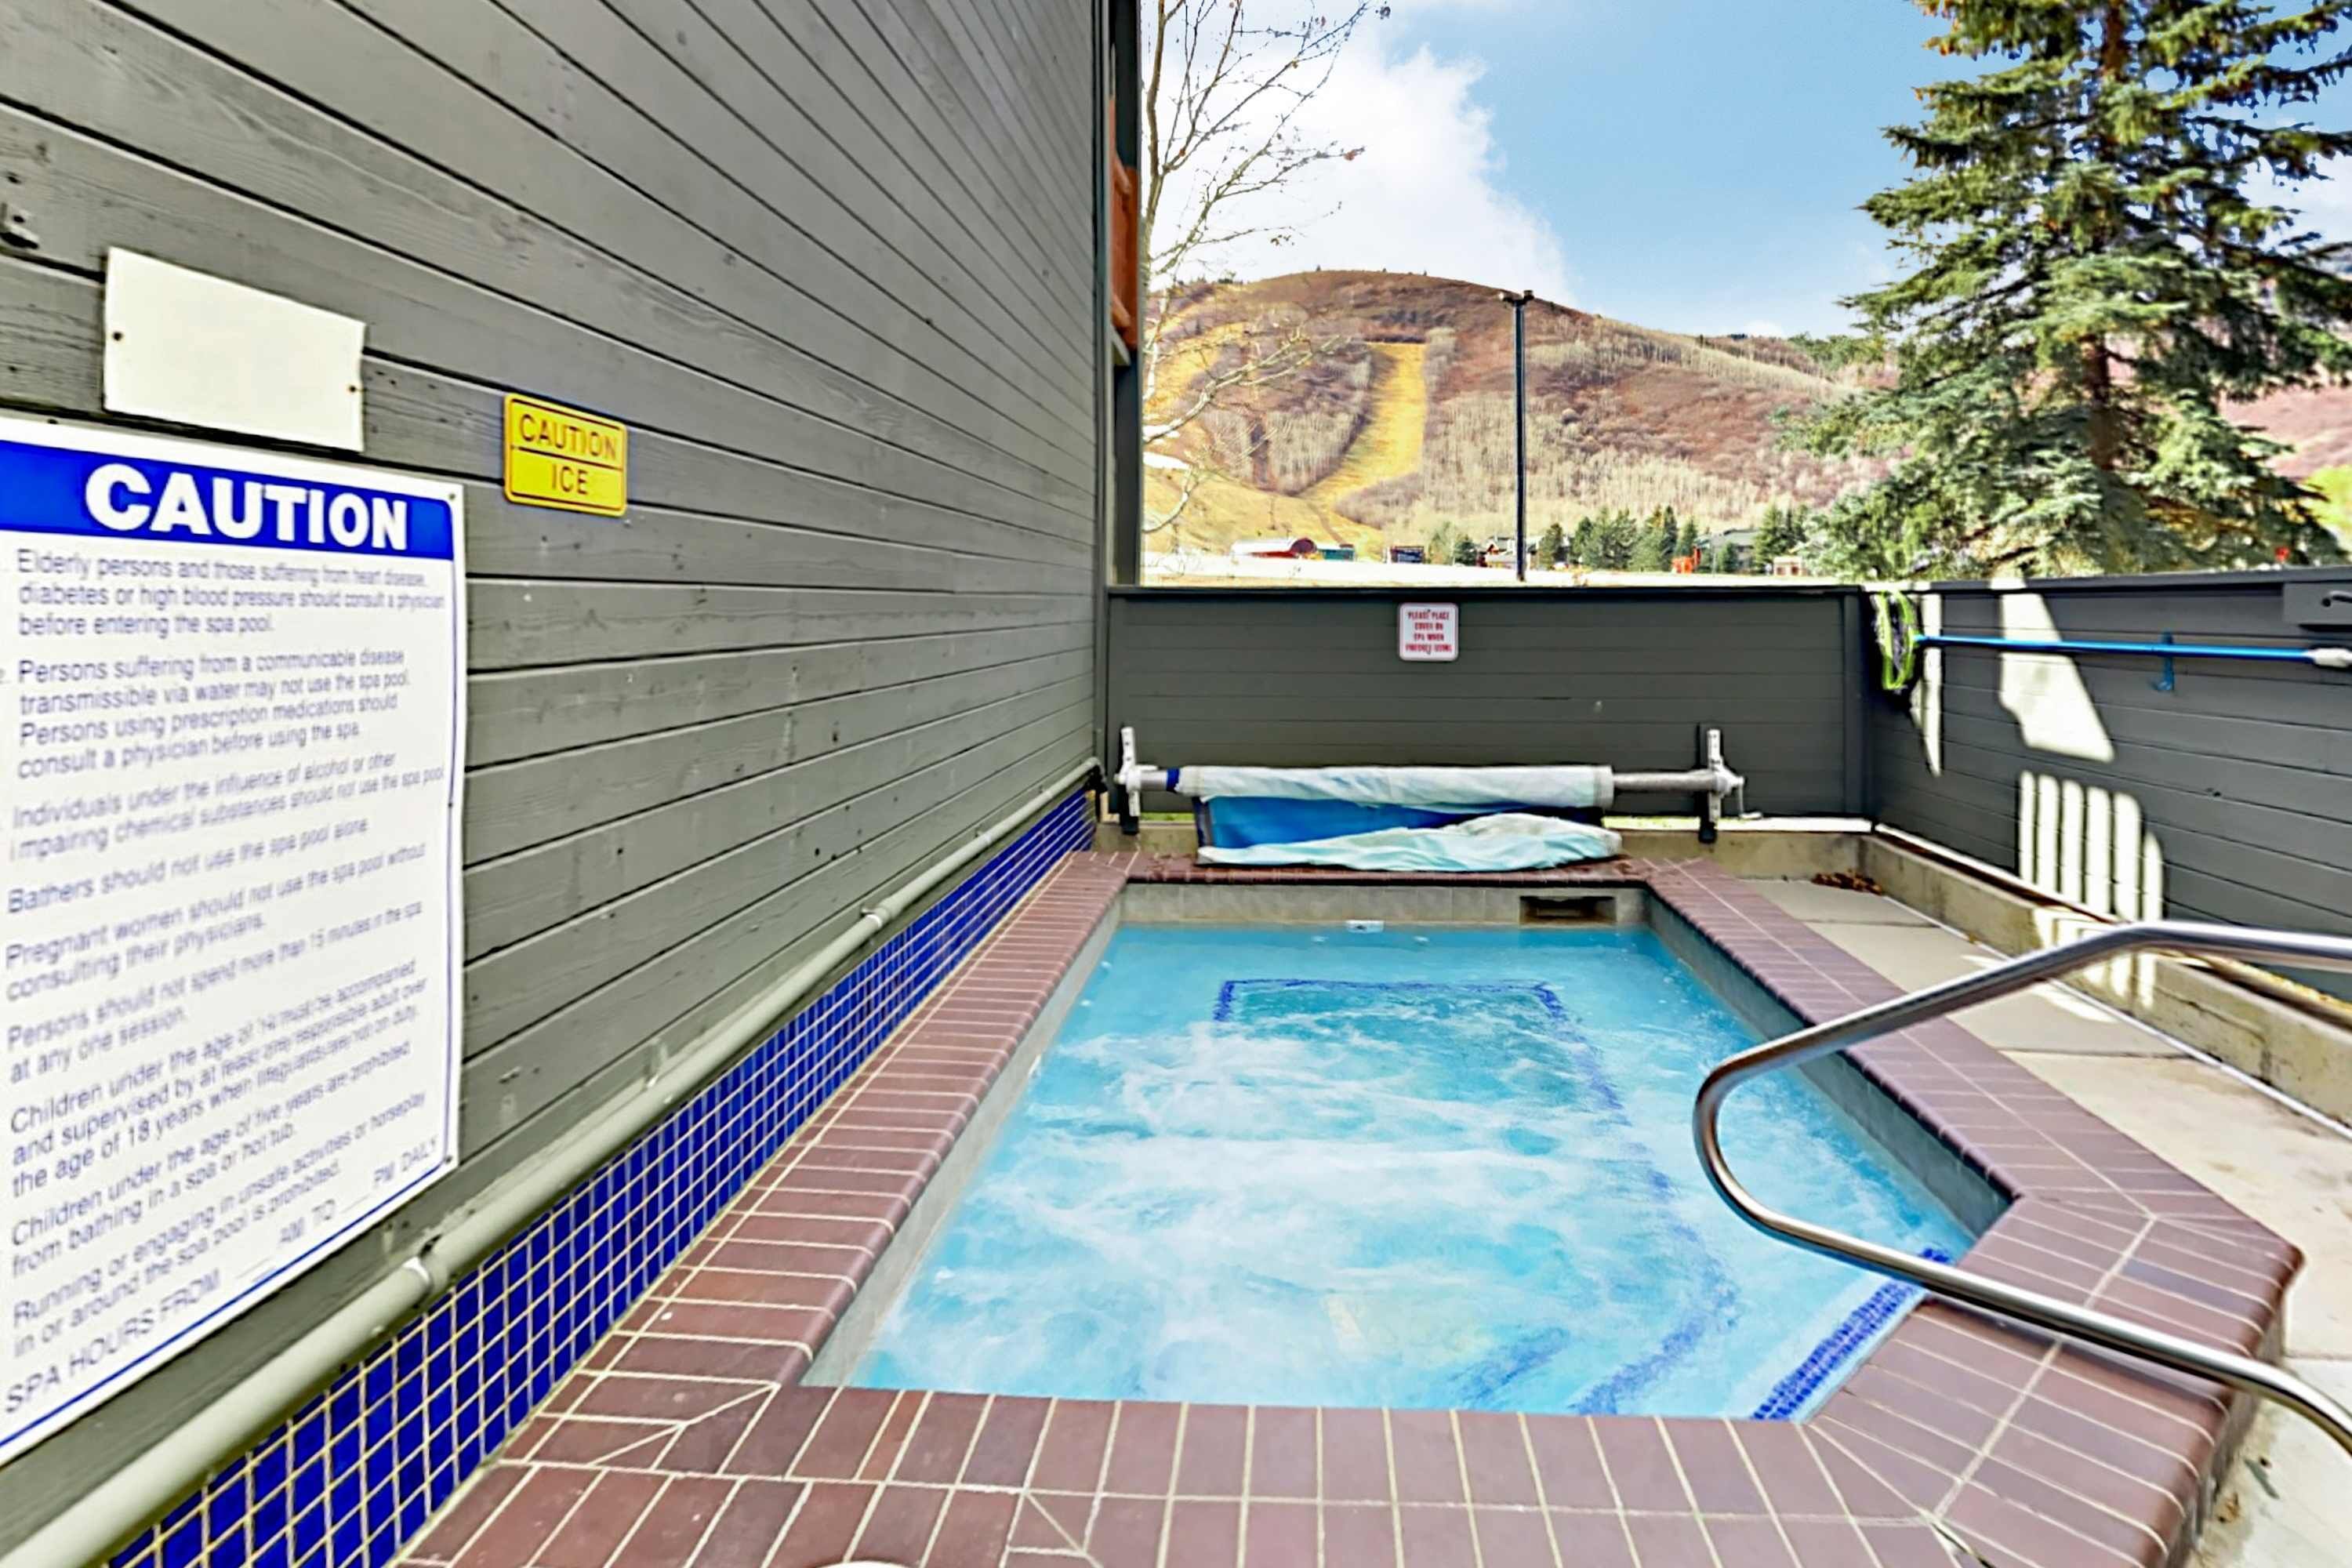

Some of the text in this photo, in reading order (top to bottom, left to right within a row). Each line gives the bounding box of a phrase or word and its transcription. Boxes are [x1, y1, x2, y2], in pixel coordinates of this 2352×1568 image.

[519, 414, 617, 460] CAUTION
[85, 463, 407, 550] CAUTION
[552, 463, 589, 495] ICE
[17, 547, 89, 579] Elderly
[97, 557, 172, 579] persons
[178, 561, 209, 578] and
[213, 561, 255, 579] those
[260, 562, 318, 586] suffering
[19, 583, 108, 604] diabetes
[115, 588, 133, 604] or
[140, 586, 176, 610] high
[183, 586, 227, 606] blood
[233, 590, 294, 607] pressure
[19, 612, 85, 636] before
[93, 615, 168, 638] entering
[174, 615, 199, 632] the
[206, 617, 234, 633] spa
[19, 659, 107, 683] Persons
[114, 655, 194, 679] suffering
[199, 654, 236, 673] from
[242, 656, 251, 672] a
[256, 651, 355, 671] communicable
[20, 686, 157, 715] transmissible
[164, 686, 188, 702] via
[195, 683, 239, 700] water
[245, 681, 275, 699] may
[20, 720, 107, 745] Persons
[115, 716, 165, 738] using
[171, 706, 267, 734] prescription
[273, 699, 354, 719] medications
[17, 748, 96, 779] consult
[103, 750, 114, 768] a
[122, 739, 207, 768] physician
[212, 731, 263, 753] before
[269, 728, 306, 746] using
[13, 793, 121, 828] Individuals
[129, 785, 178, 811] under
[184, 782, 209, 800] the
[216, 771, 281, 794] influence
[8, 879, 93, 913] Bathers
[101, 860, 165, 894] should
[171, 854, 199, 876] not
[205, 848, 234, 870] use
[240, 842, 263, 860] the
[270, 834, 296, 855] spa
[6, 925, 107, 968] Pregnant
[114, 908, 181, 940] women
[189, 889, 244, 922] should
[249, 883, 272, 902] not
[6, 953, 119, 1001] consulting
[126, 939, 168, 967] their
[10, 1058, 28, 1083] at
[38, 1048, 71, 1074] any
[78, 1032, 112, 1060] one
[10, 1022, 252, 1133] Children under the age of
[13, 1065, 215, 1166] and supervised by at
[13, 1079, 250, 1197] the age of 18 years when
[12, 1113, 250, 1246] Children under the age of
[13, 1240, 60, 1277] from
[69, 1200, 141, 1249] bathing
[149, 1189, 163, 1208] in
[169, 1180, 180, 1197] a
[186, 1162, 216, 1189] spa
[221, 1151, 236, 1171] or
[241, 1134, 266, 1159] hot
[13, 1268, 101, 1327] Running
[108, 1254, 126, 1276] or
[133, 1206, 214, 1262] engaging
[220, 1195, 234, 1214] in
[238, 1166, 288, 1203] unsafe
[14, 1204, 264, 1358] in or around the spa pool is
[5, 1365, 60, 1413] SPA
[69, 1308, 154, 1375] HOURS
[160, 1269, 218, 1319] FROM
